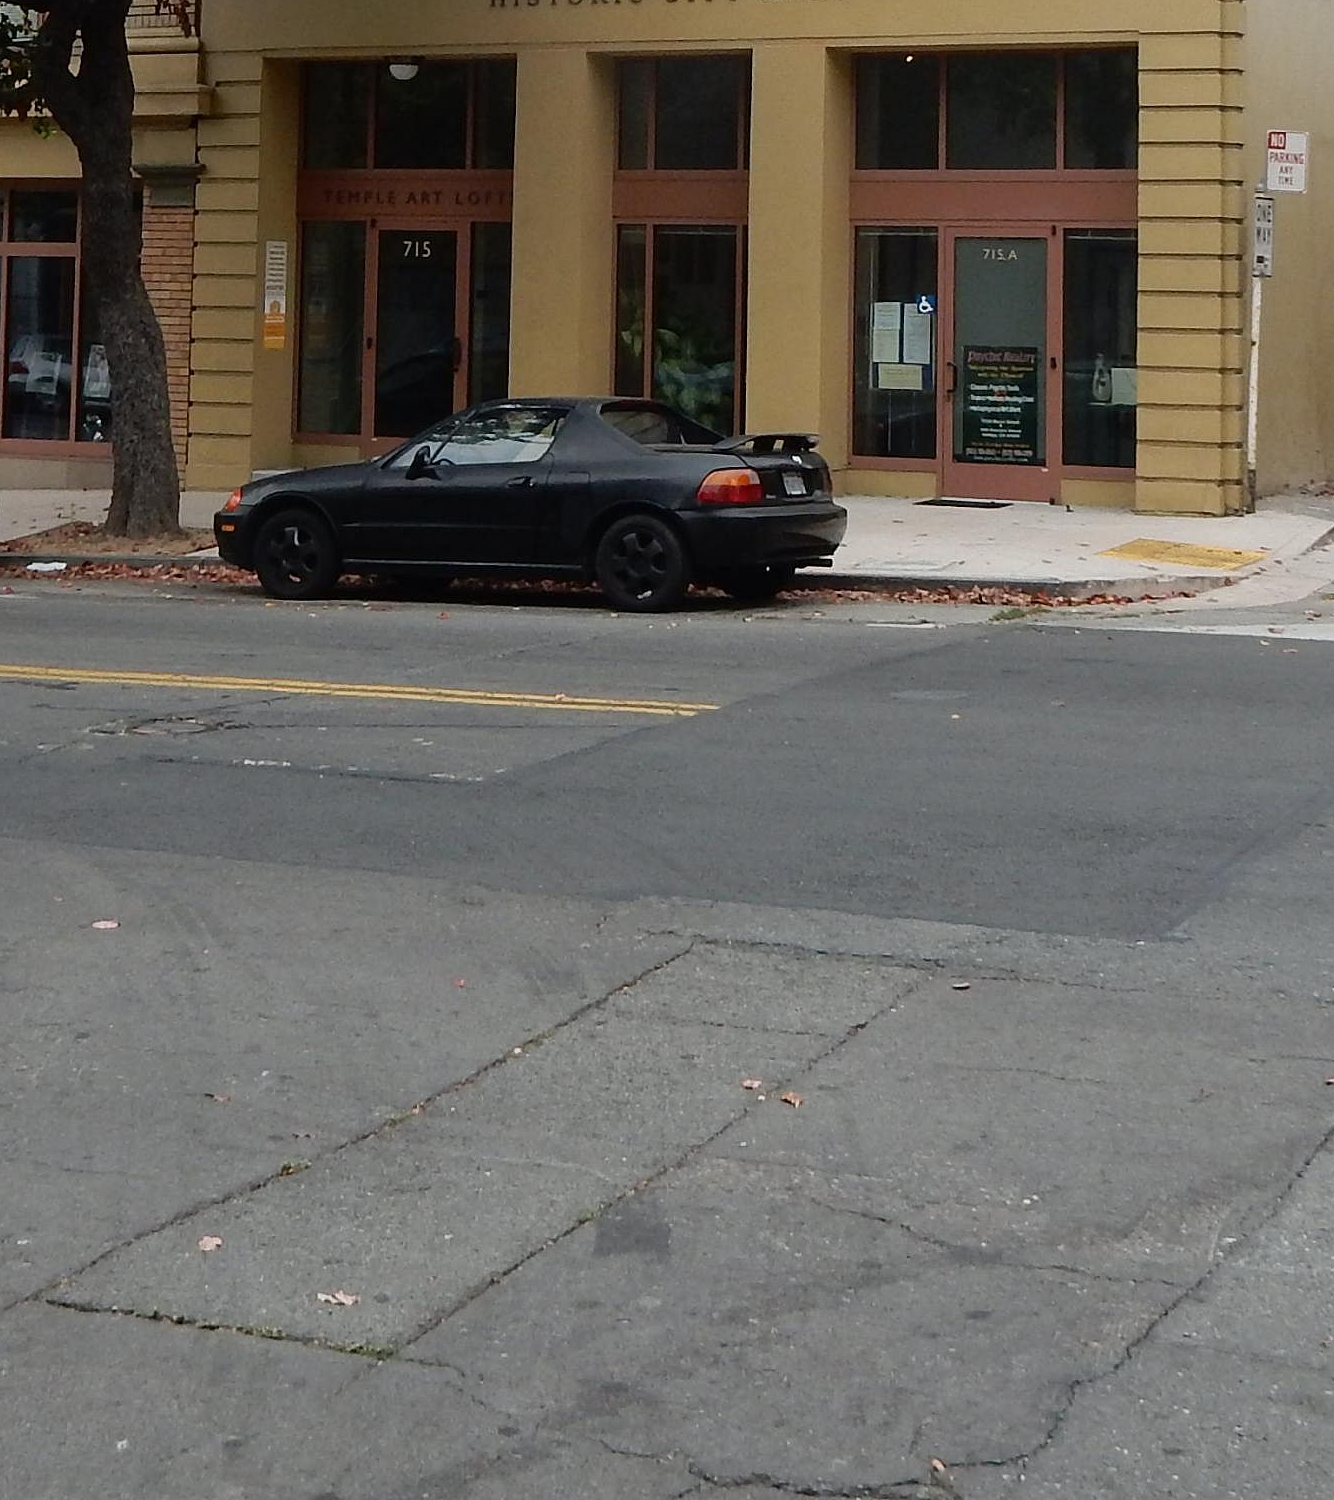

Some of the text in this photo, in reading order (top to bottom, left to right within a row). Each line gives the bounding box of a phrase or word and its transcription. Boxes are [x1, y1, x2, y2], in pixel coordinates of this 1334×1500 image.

[1270, 133, 1285, 148] NO
[1269, 151, 1304, 165] PARKING
[1279, 165, 1294, 175] ANY
[1278, 176, 1294, 186] TIME
[324, 190, 513, 206] TEMPLE ART LOFT
[402, 240, 432, 258] 715
[982, 248, 1018, 260] 715 A
